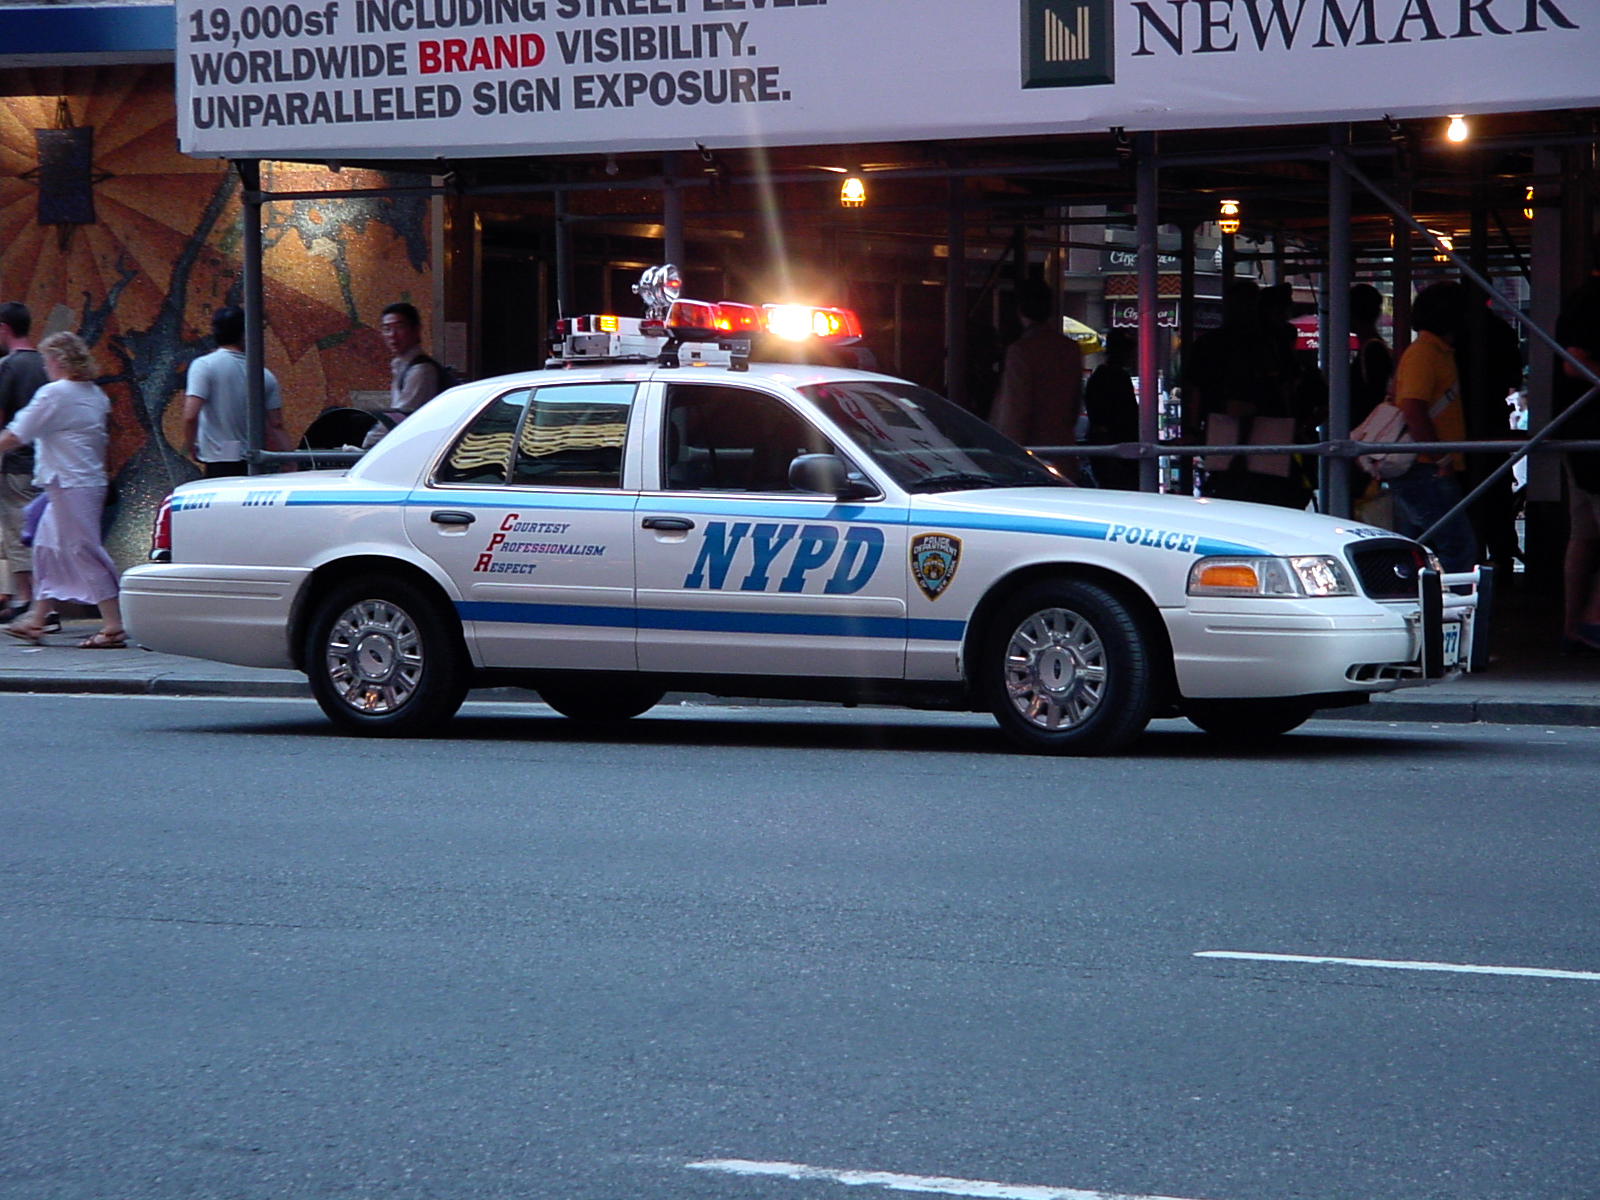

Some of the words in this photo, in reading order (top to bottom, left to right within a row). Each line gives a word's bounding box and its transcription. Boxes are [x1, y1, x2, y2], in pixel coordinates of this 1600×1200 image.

[189, 1, 339, 48] 19,000sf
[355, 0, 546, 33] INCLUDING
[1130, 0, 1580, 56] NEWMARK
[190, 42, 408, 86] WORLDWIDE
[418, 33, 546, 74] BRAND
[555, 22, 757, 64] VISIBILITY.
[191, 84, 462, 130] UNPARALLELED
[472, 76, 561, 115] SIGN
[573, 66, 792, 109] EXPOSURE.
[485, 533, 606, 556] PROFESSIONALISM
[499, 513, 570, 534] COURTESY
[1108, 524, 1197, 553] POLICE
[473, 553, 537, 575] RESPECT
[682, 520, 885, 595] NYPD
